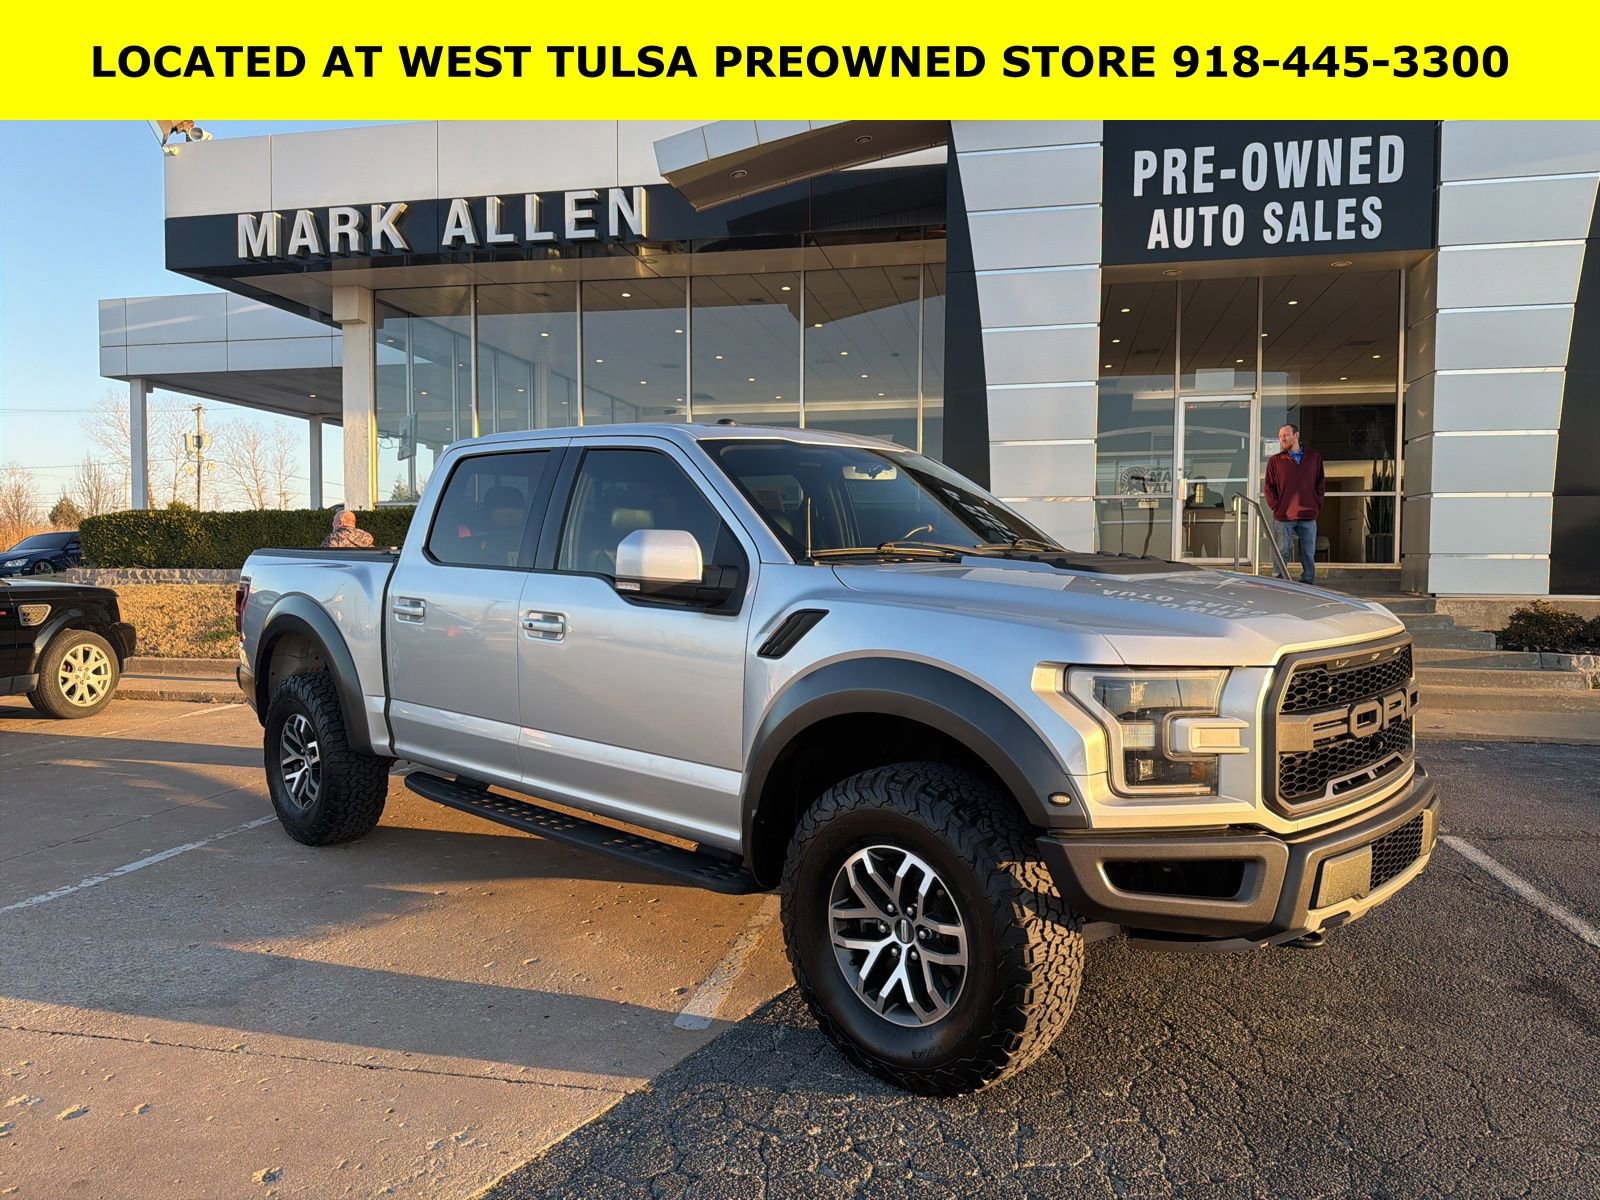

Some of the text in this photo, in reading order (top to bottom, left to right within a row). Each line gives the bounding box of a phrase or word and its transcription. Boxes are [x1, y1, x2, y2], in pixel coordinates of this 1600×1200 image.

[1133, 135, 1405, 197] PRE-OWNED
[237, 186, 647, 261] MARK ALLEN
[1147, 196, 1383, 250] AUTO SALES
[1305, 685, 1420, 751] FORD
